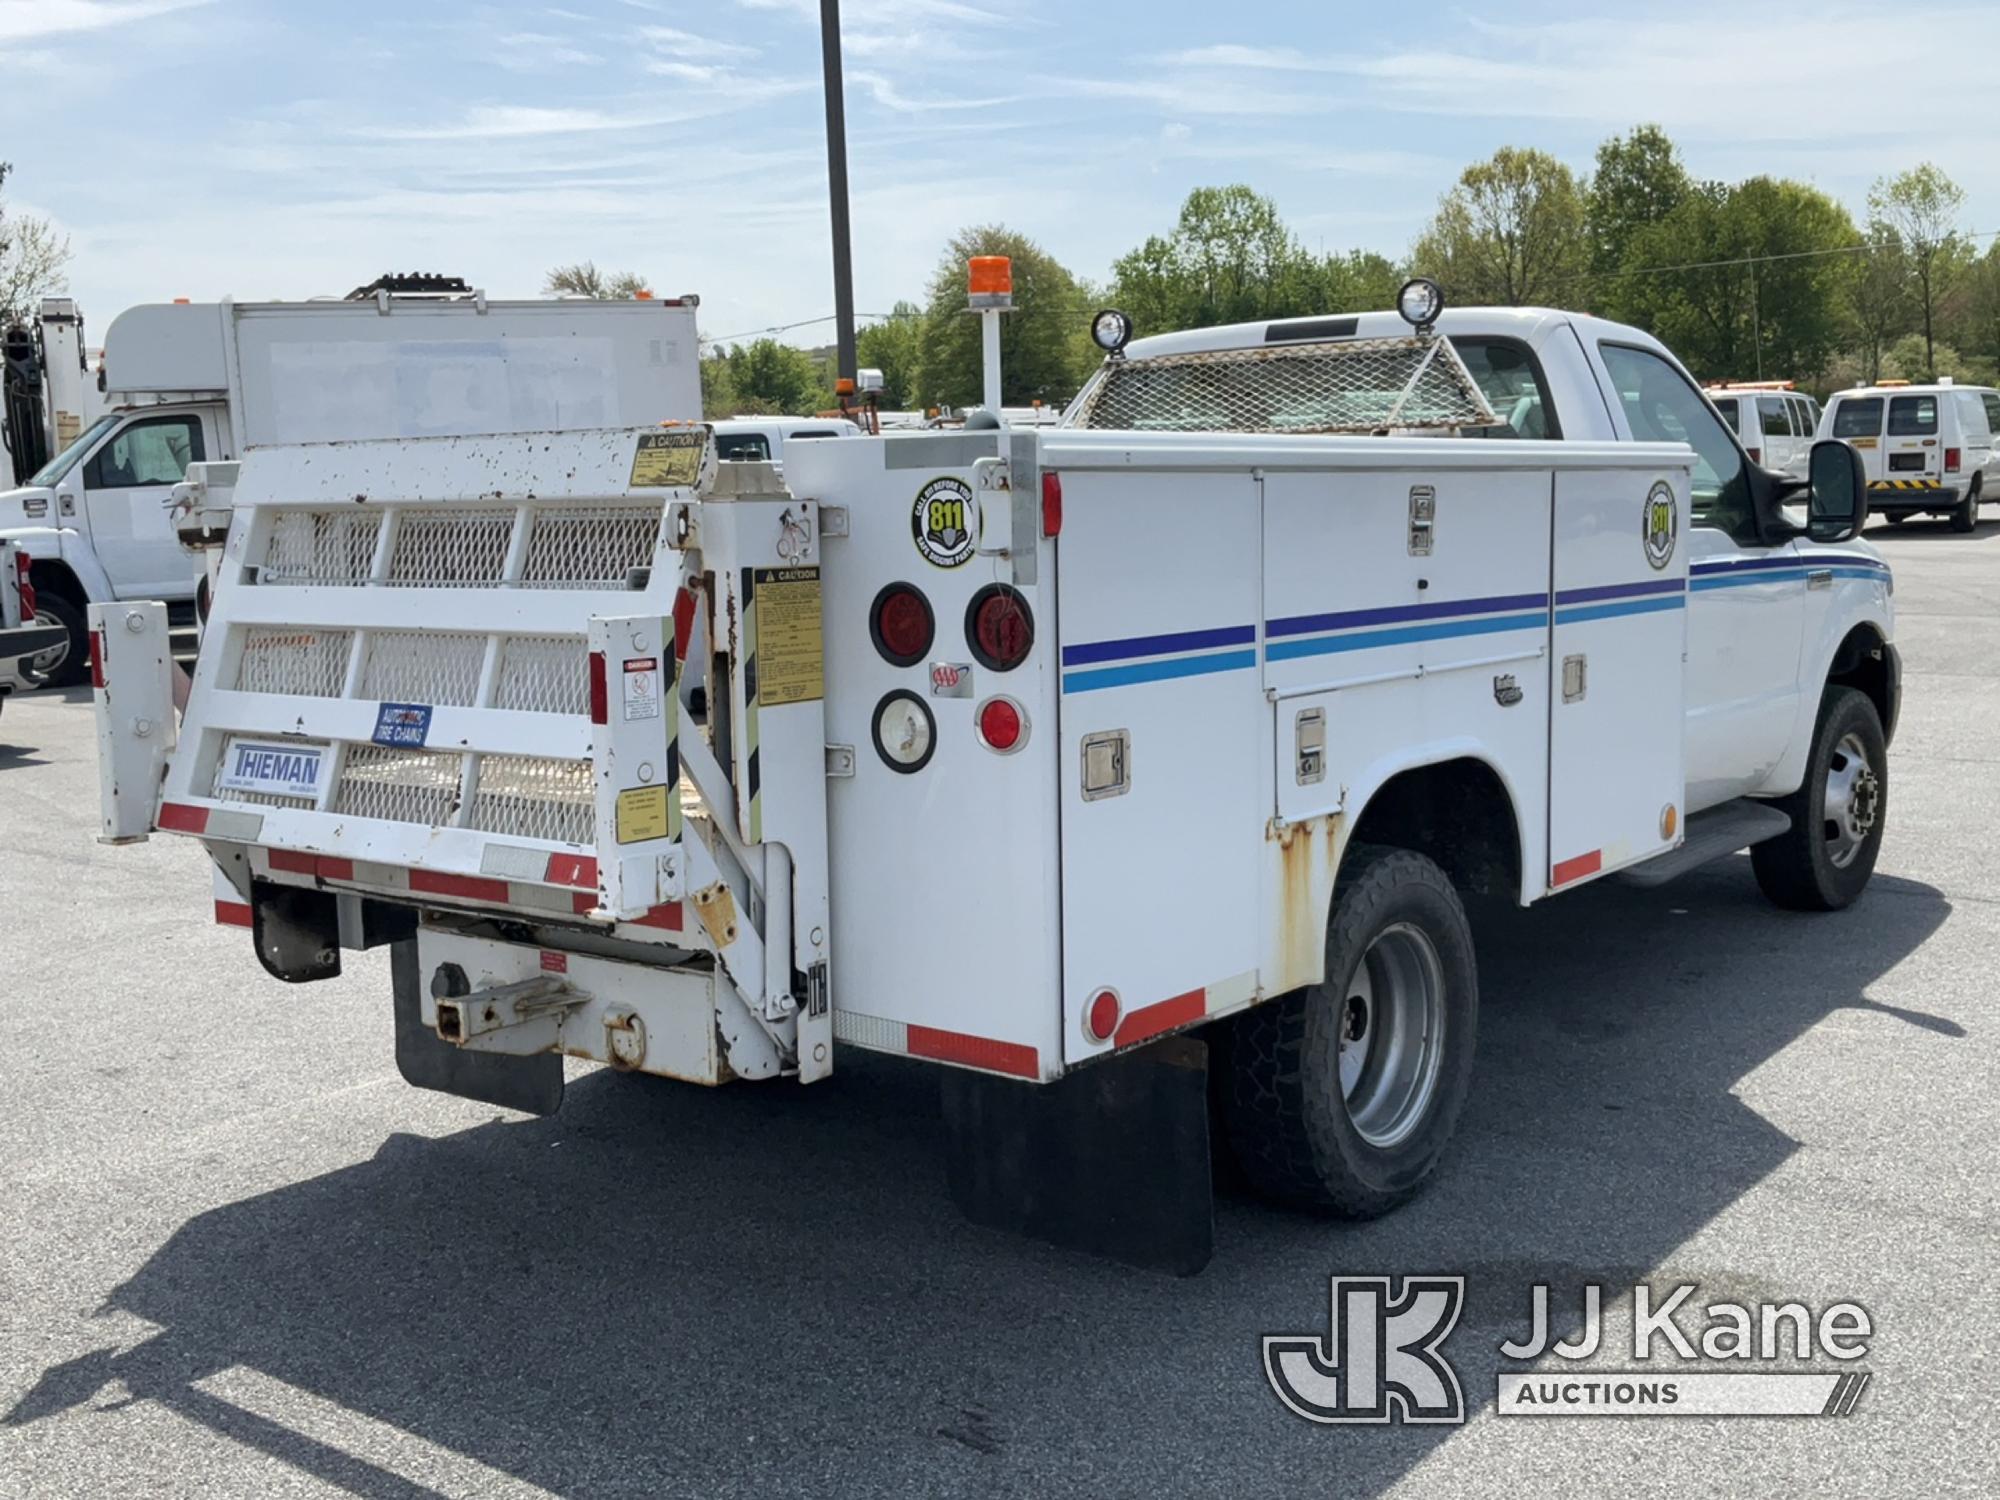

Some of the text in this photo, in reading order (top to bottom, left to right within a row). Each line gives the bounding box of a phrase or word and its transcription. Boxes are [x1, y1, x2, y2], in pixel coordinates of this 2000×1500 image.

[657, 433, 696, 447] CAUTION
[930, 501, 963, 531] 811
[1654, 503, 1669, 533] 811
[235, 744, 321, 784] THIEMAN
